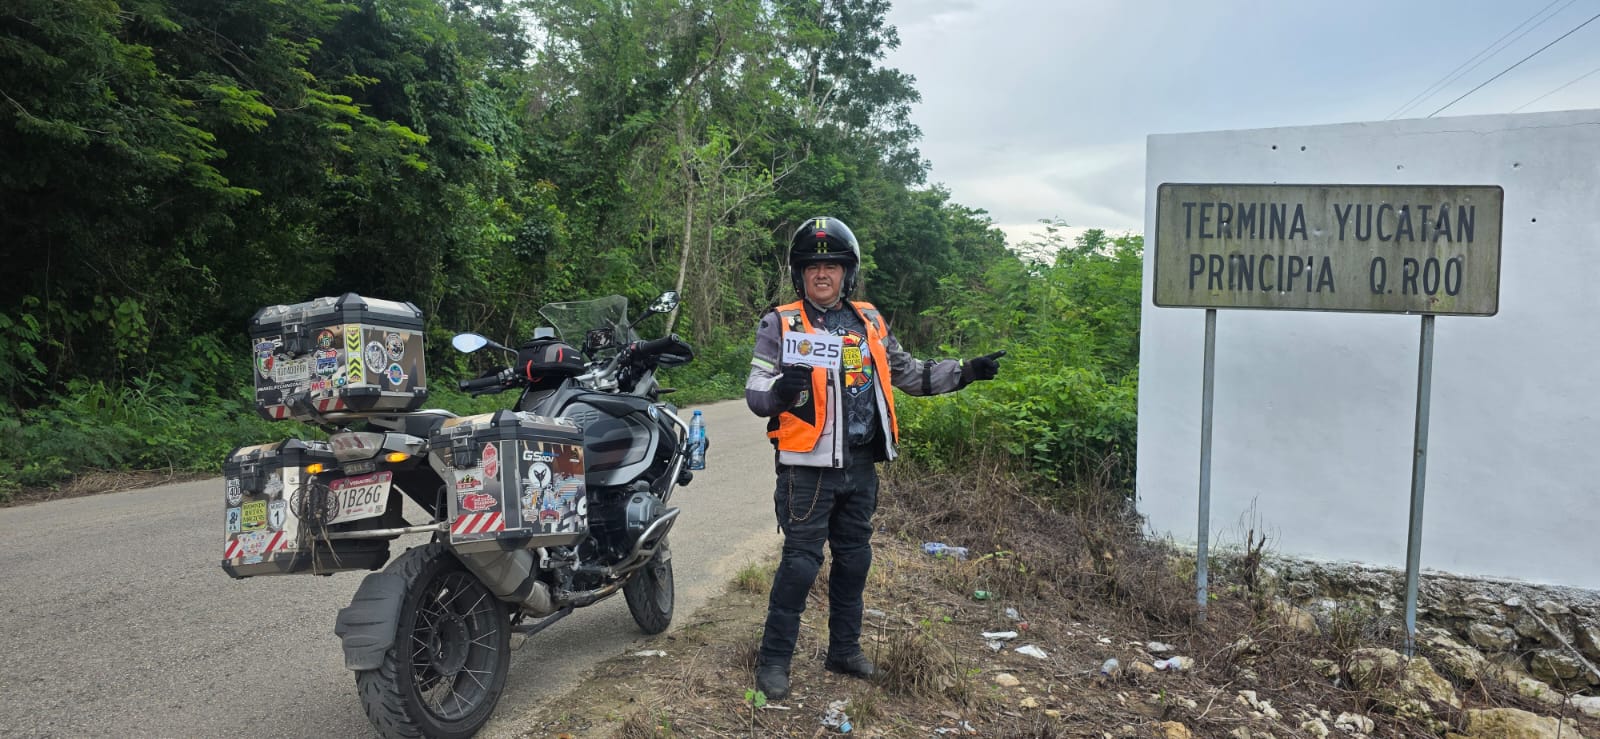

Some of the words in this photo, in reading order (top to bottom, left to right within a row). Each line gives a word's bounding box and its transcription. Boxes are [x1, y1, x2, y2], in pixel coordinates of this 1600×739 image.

[1182, 201, 1309, 242] TERMINA
[1333, 203, 1476, 243] YUCATAN
[1188, 253, 1336, 294] PRINCIPIA
